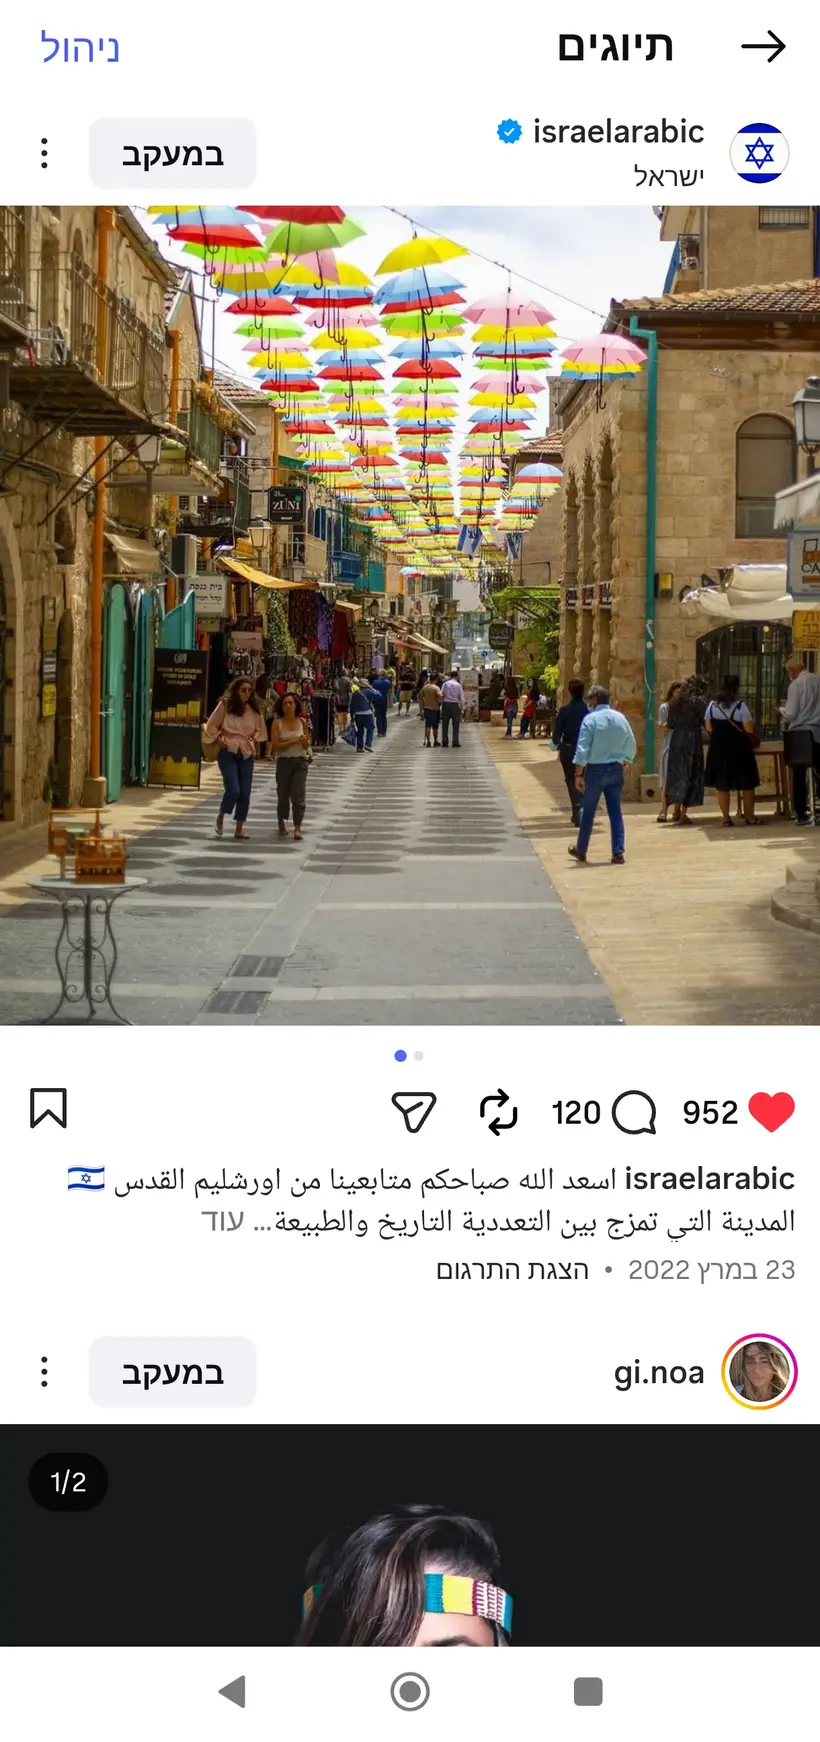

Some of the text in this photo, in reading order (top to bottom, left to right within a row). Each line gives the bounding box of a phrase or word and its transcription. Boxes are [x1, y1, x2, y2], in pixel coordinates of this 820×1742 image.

[41, 30, 119, 63] ניהול
[558, 33, 673, 62] תיוגים
[534, 118, 704, 144] israelarabic
[122, 145, 225, 173] במעקב
[634, 164, 704, 187] ישראל
[209, 583, 223, 592] בית
[552, 1100, 600, 1124] 120
[683, 1100, 738, 1124] 952
[115, 1166, 795, 1198] israelarabic اسعد الله صباحكم متابعينا من اورشليم القدس
[201, 1211, 244, 1232] עוד
[378, 1209, 451, 1240] التاريخ
[463, 1209, 551, 1237] التعددية
[561, 1218, 597, 1239] بين
[607, 1211, 658, 1240] تمزج
[667, 1209, 711, 1243] التي
[722, 1209, 795, 1237] المدينة
[437, 1262, 588, 1280] הצגת התרגום
[629, 1260, 795, 1285] 23 במרץ 2022
[122, 1363, 225, 1391] במעקב
[615, 1359, 705, 1392] gi.noa
[51, 1469, 86, 1494] 1/2
